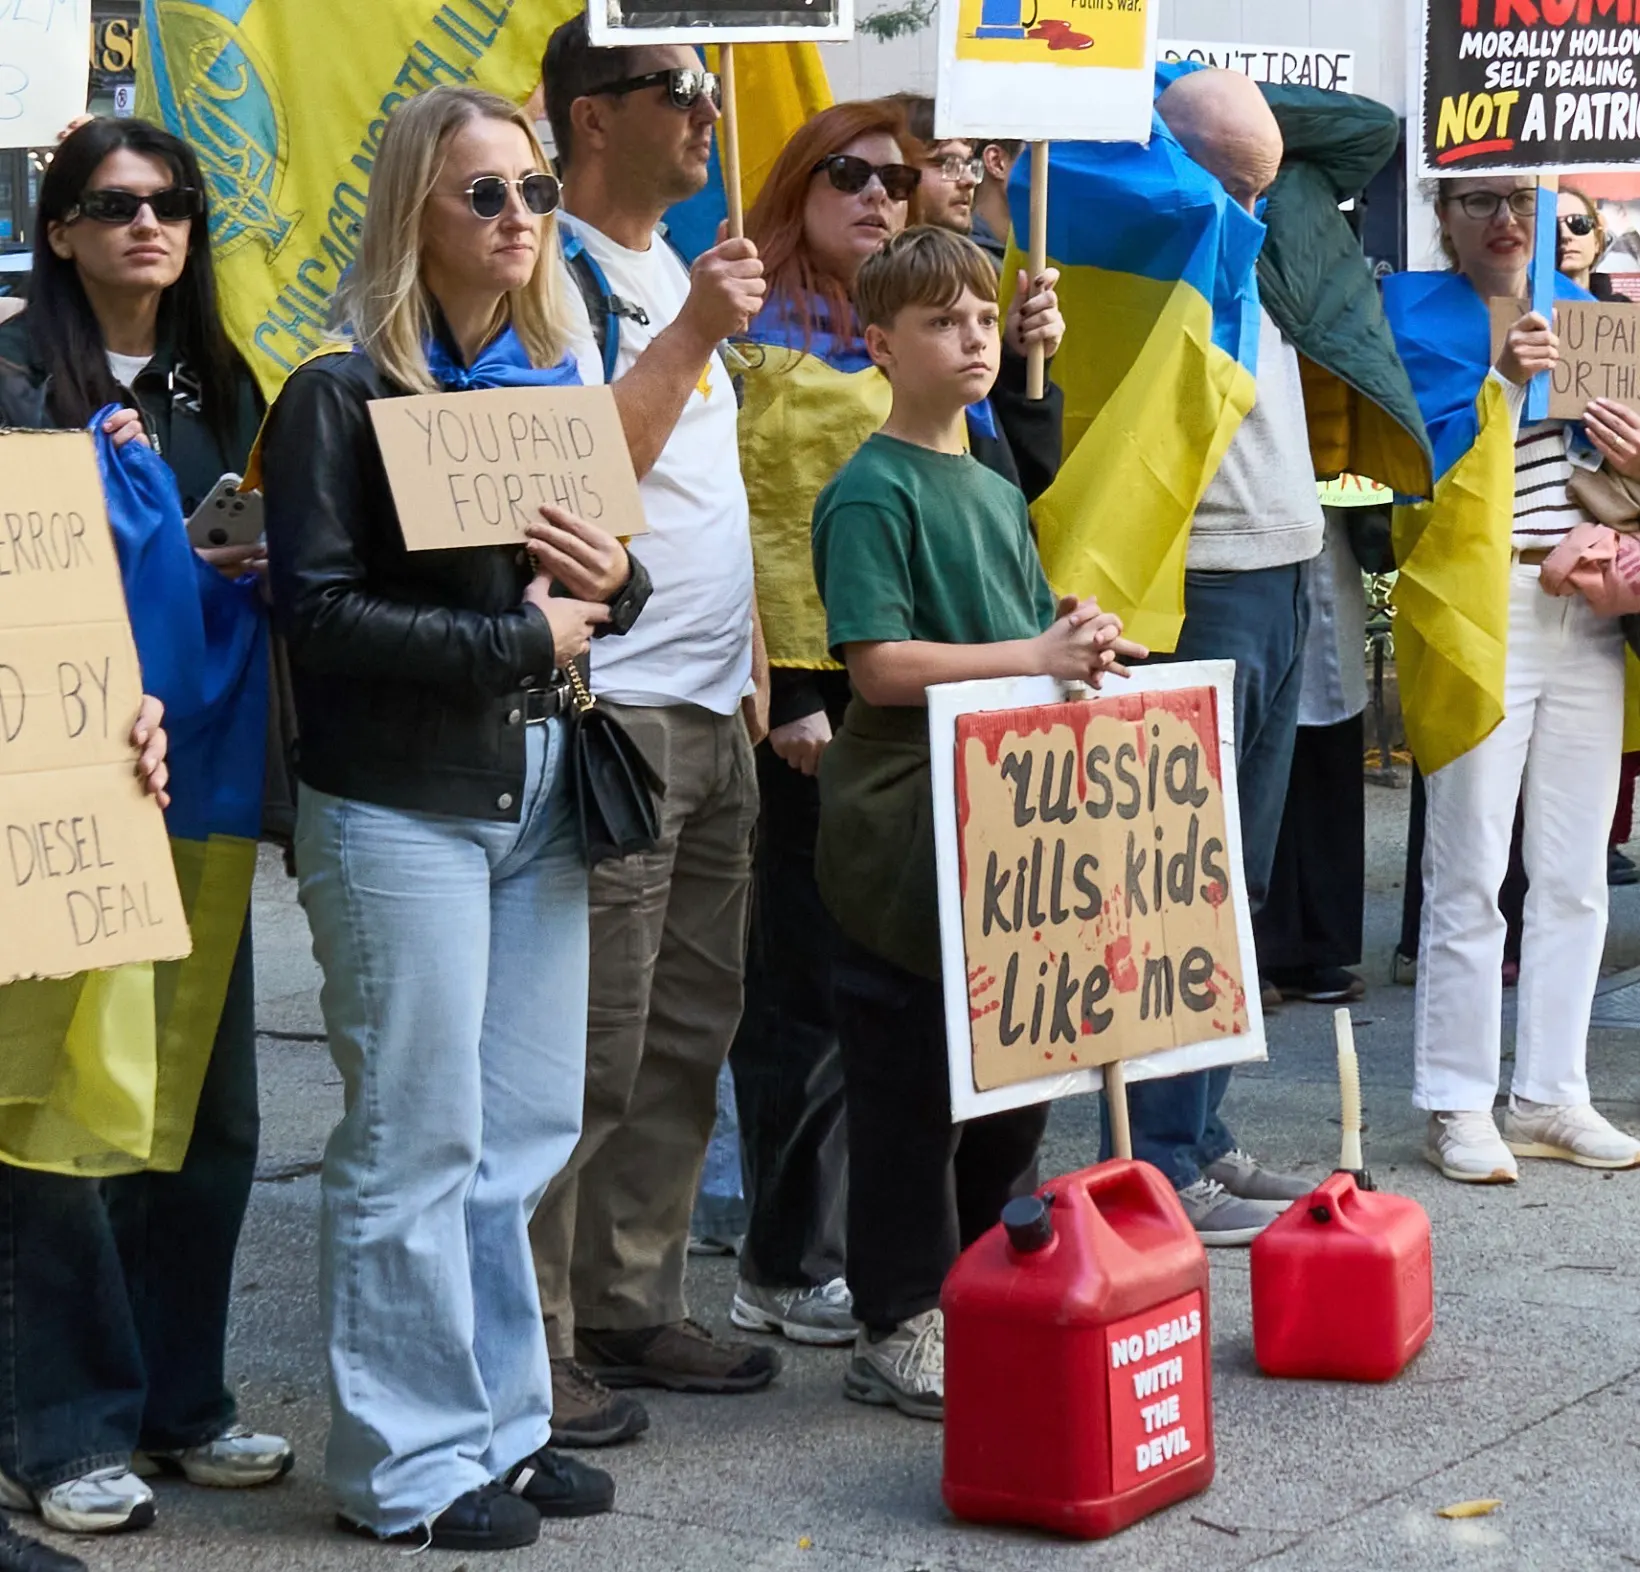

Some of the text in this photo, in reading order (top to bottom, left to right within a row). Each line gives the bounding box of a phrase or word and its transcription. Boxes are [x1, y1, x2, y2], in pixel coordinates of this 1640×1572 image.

[1071, 0, 1113, 10] Putins
[1460, 0, 1640, 28] RUM
[1263, 52, 1351, 91] TRADE
[1459, 31, 1565, 60] MORALLY
[1484, 58, 1637, 89] SELF DEALING,
[1436, 90, 1640, 149] NOT A PATRI
[1552, 358, 1593, 398] OR
[404, 409, 501, 466] YOU
[449, 472, 532, 532] FOR
[58, 656, 110, 741] BY
[1000, 724, 1209, 828] russia
[7, 814, 115, 887] DIESEL
[982, 813, 1229, 937] kills kids
[66, 881, 163, 947] DEAL
[1139, 946, 1217, 1021] me
[1110, 1309, 1201, 1369] NO DEALS
[1132, 1355, 1183, 1400] WITH
[1140, 1394, 1180, 1433] THE
[1135, 1426, 1191, 1472] DEVIL
